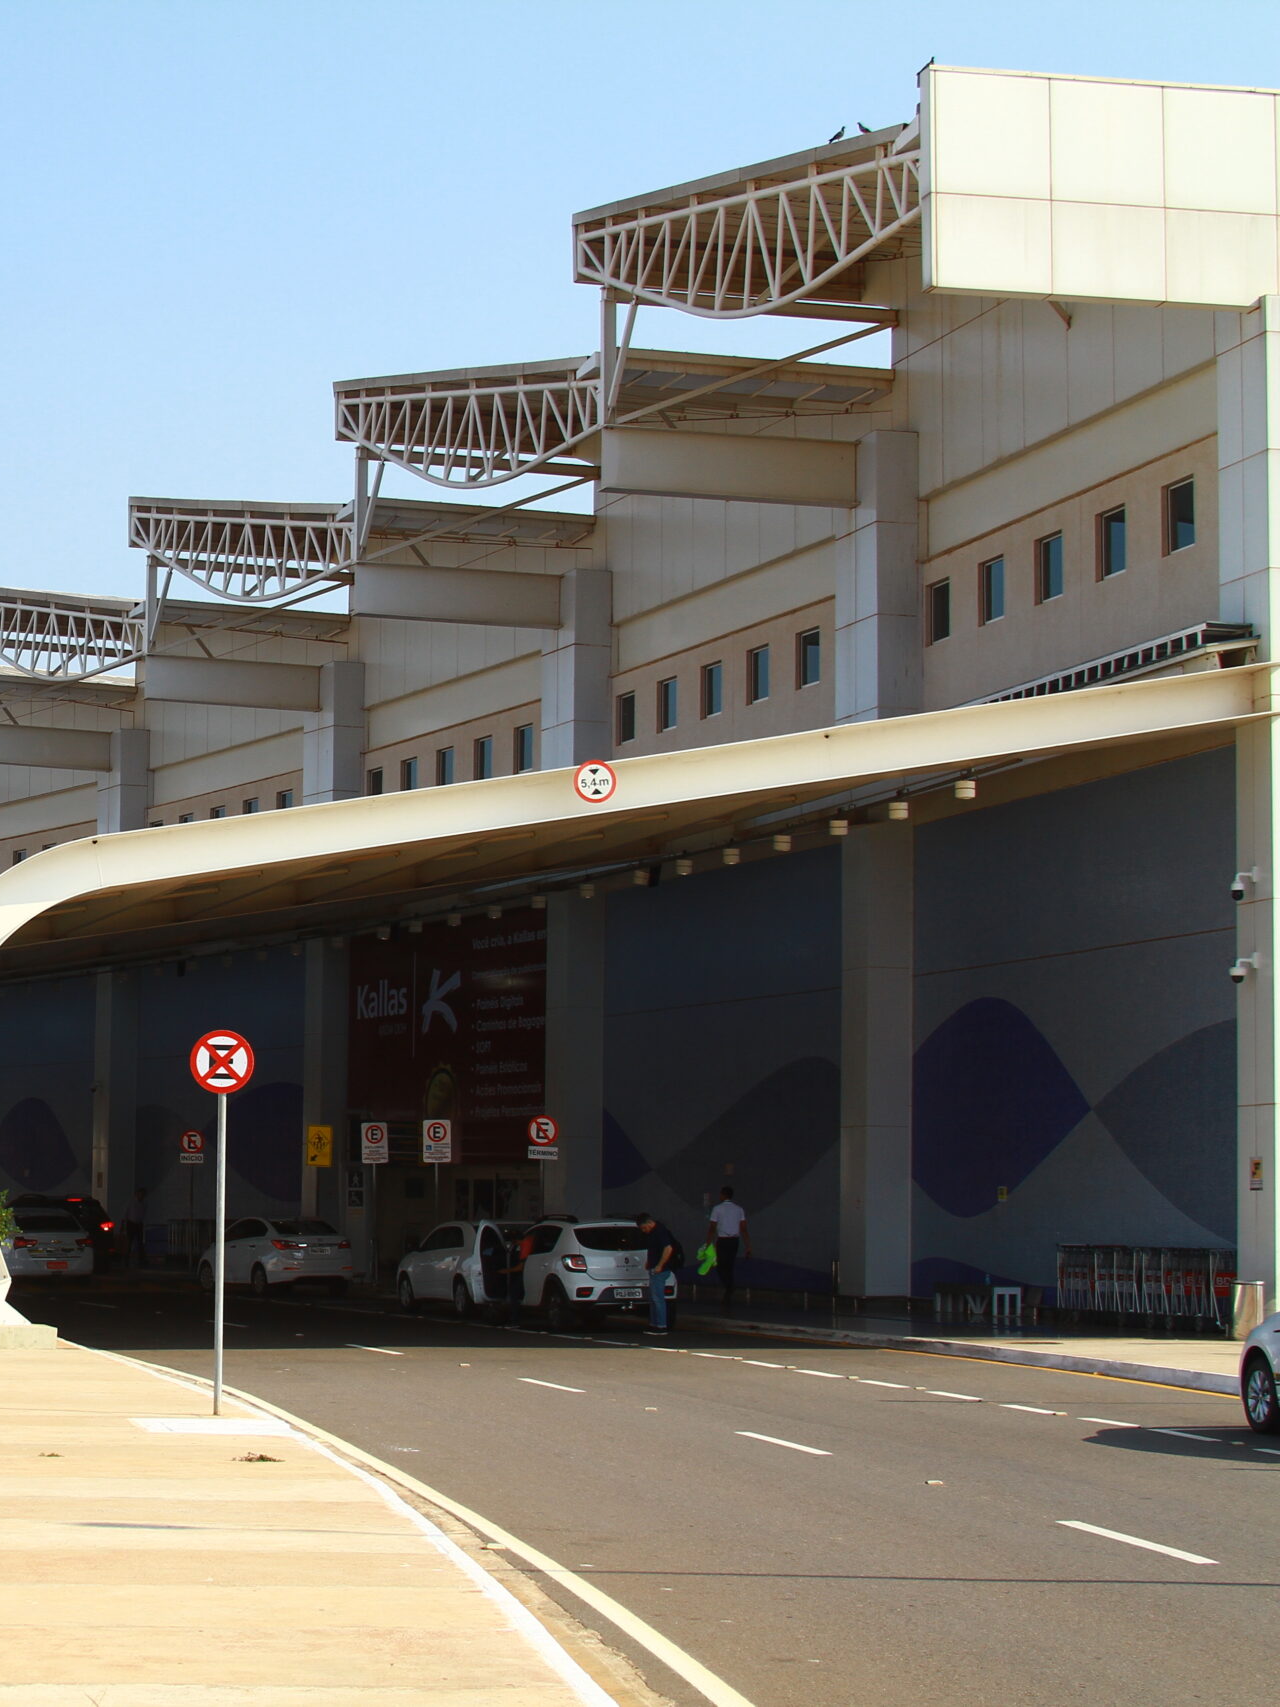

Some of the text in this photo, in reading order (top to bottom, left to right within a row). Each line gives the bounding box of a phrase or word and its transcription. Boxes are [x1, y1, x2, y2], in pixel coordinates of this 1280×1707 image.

[581, 778, 609, 788] 5,4 m
[356, 979, 408, 1020] Kallas
[371, 1128, 378, 1140] E
[433, 1126, 440, 1139] E
[529, 1148, 558, 1158] TÉRMINO
